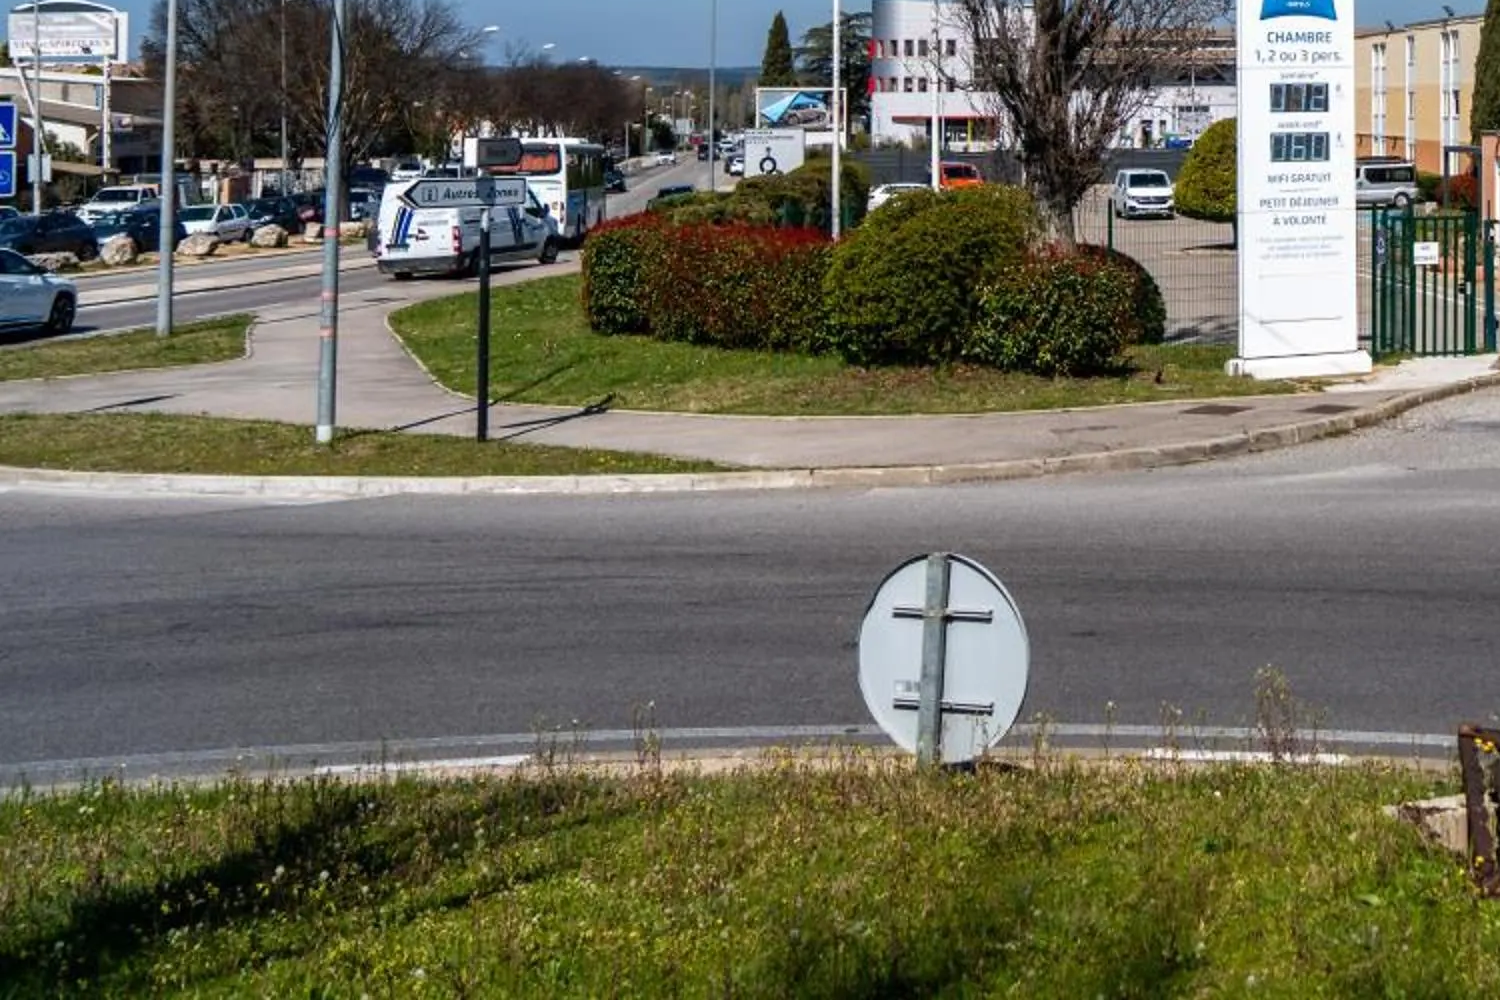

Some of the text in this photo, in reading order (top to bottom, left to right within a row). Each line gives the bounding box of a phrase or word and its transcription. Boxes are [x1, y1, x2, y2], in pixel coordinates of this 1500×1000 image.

[1266, 30, 1333, 45] CHAMBRE
[1268, 49, 1277, 62] 2
[1280, 51, 1297, 62] ou
[1301, 49, 1309, 62] 3
[1312, 50, 1344, 64] pers.
[1291, 172, 1331, 184] GRATUIT
[443, 187, 479, 199] Autres
[1259, 198, 1287, 208] PETIT
